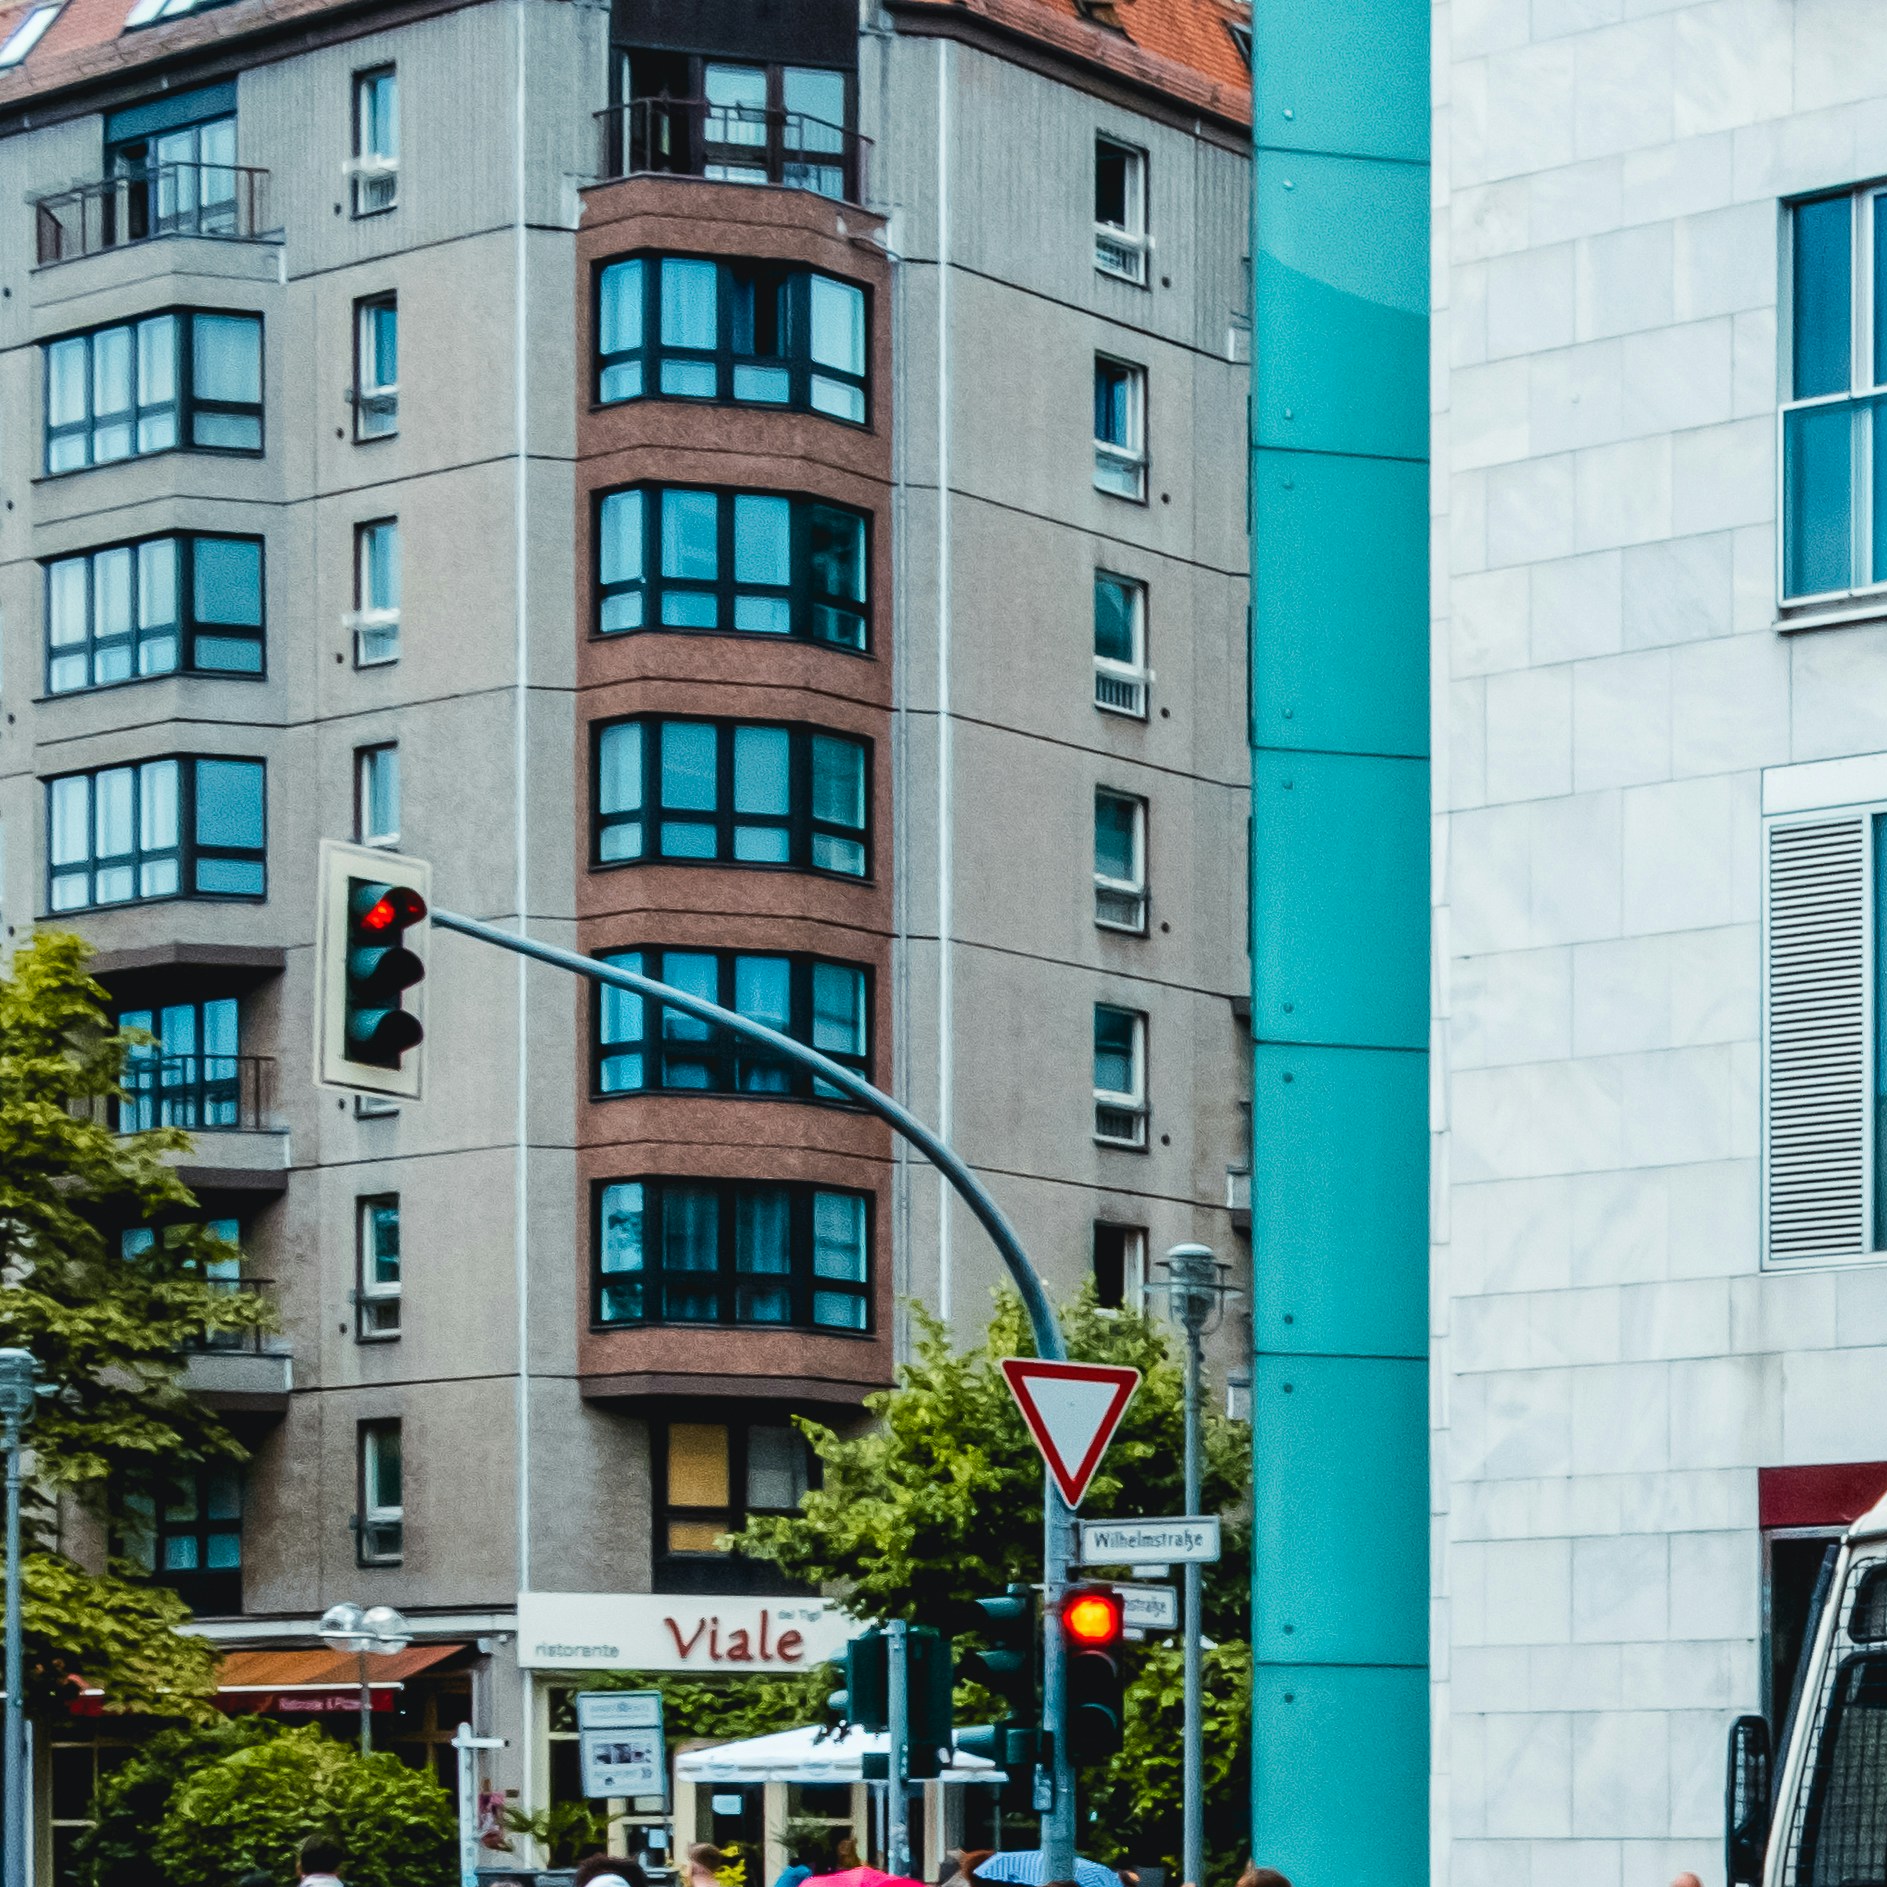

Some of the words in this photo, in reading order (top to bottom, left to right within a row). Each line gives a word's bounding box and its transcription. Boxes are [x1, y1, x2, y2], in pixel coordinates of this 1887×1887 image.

[1094, 1529, 1203, 1551] Wilhelmstraße
[663, 1609, 805, 1663] Viale
[535, 1641, 620, 1658] ristorante
